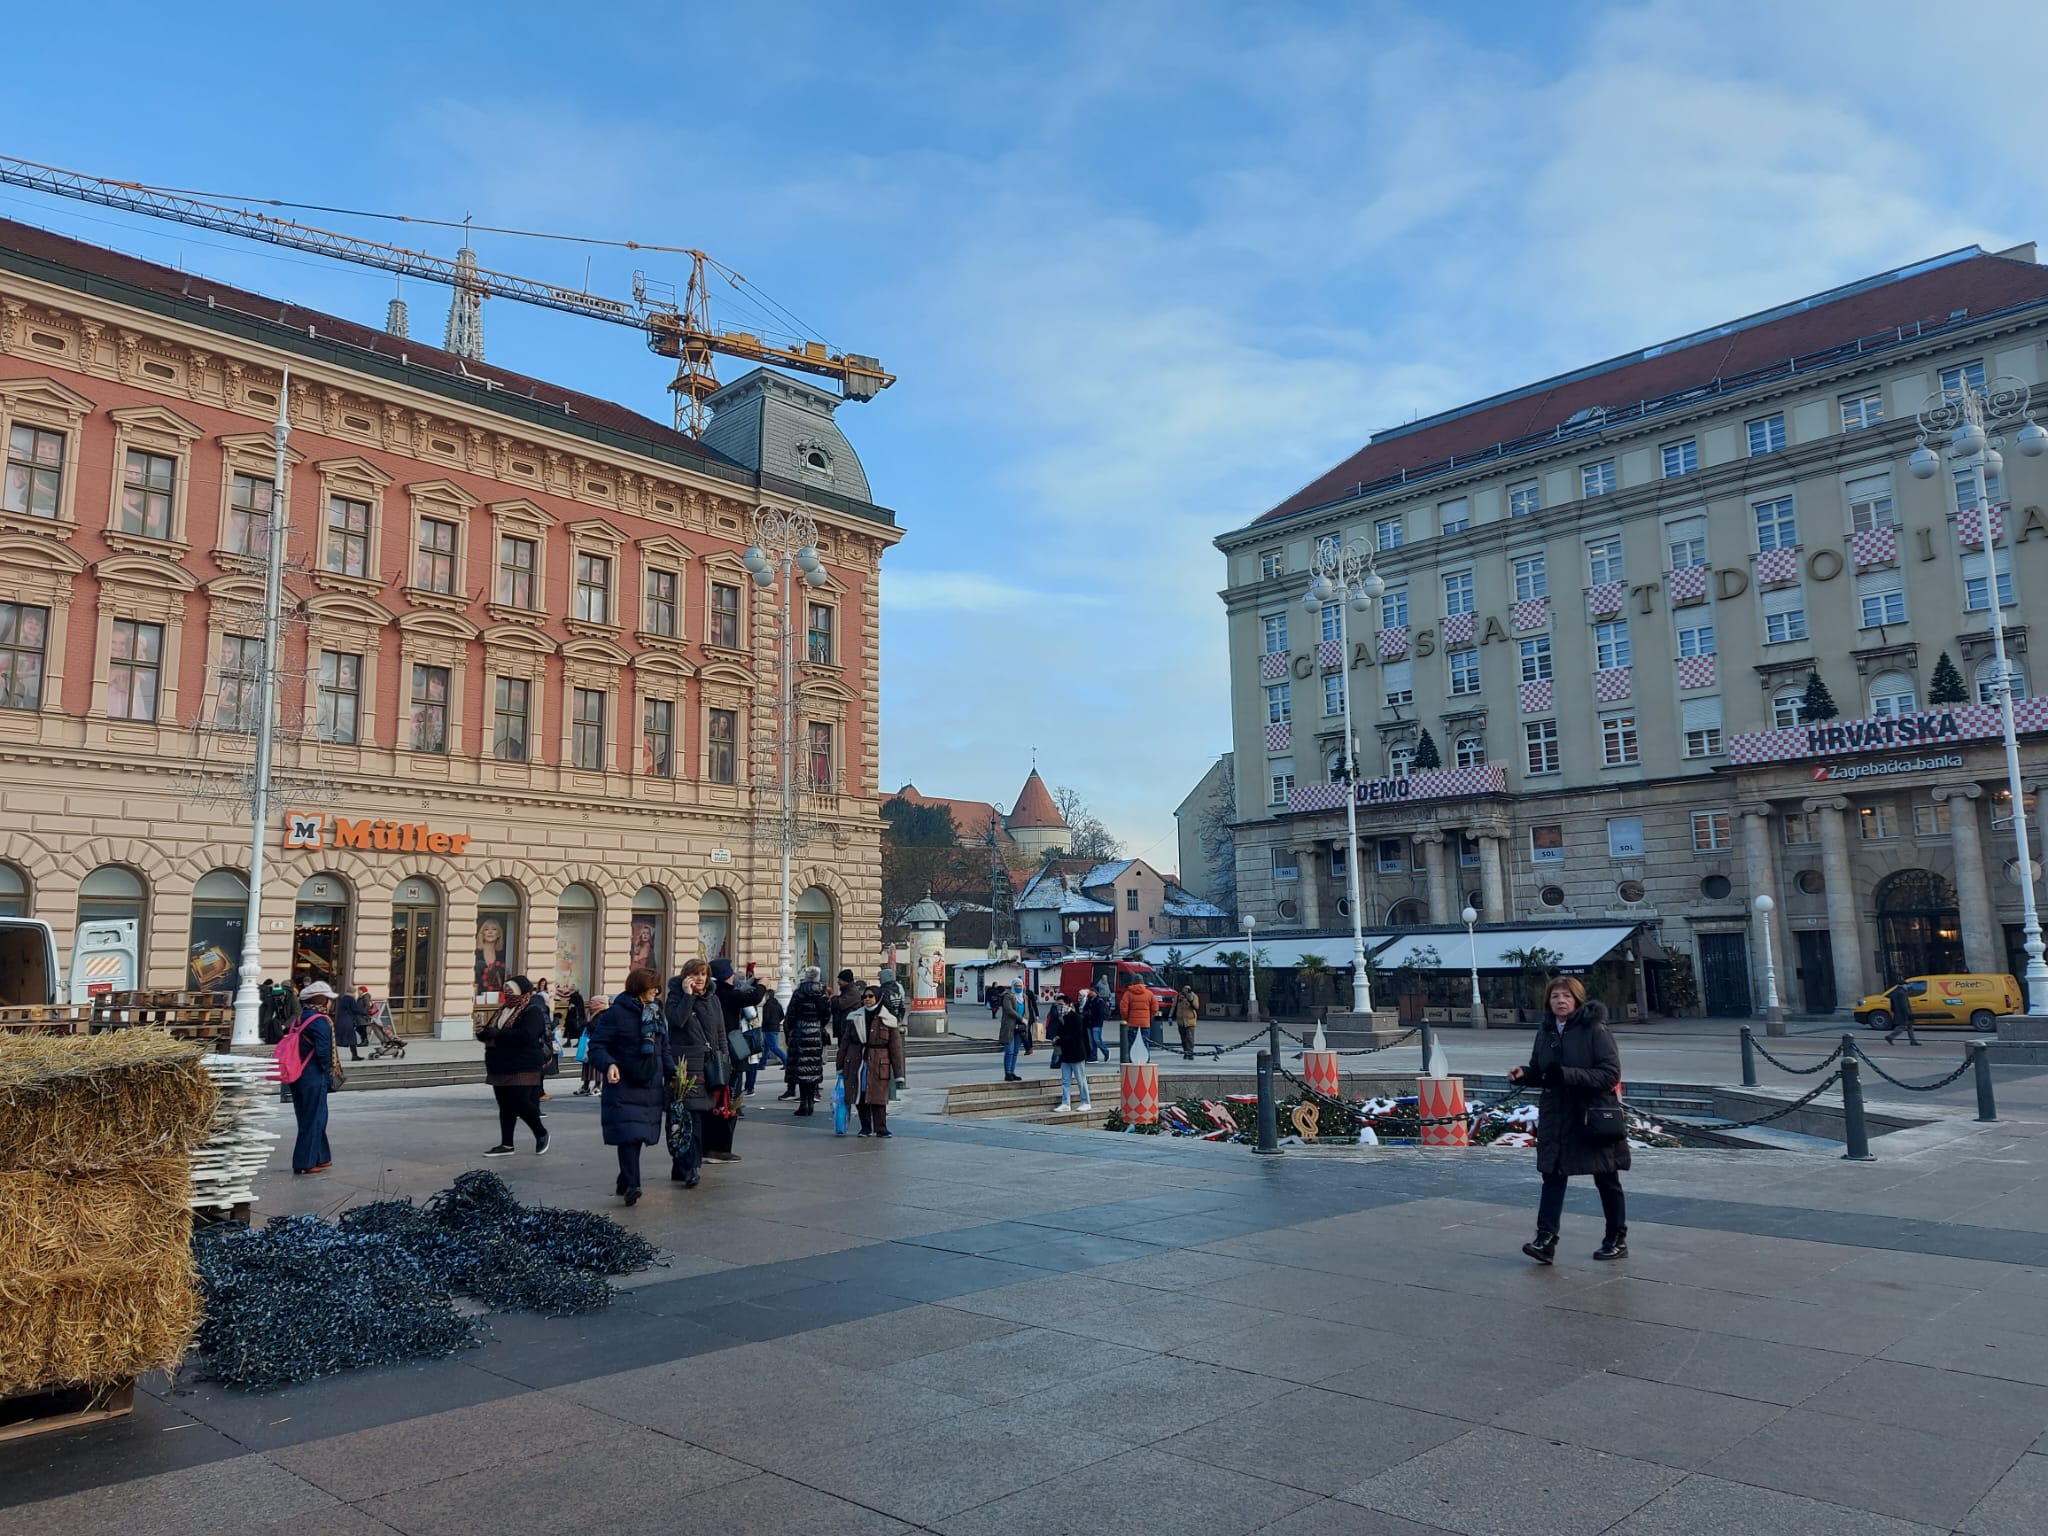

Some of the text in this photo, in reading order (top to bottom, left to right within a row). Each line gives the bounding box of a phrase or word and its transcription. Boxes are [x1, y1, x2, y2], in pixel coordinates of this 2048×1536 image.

[1808, 713, 1959, 751] HRVATSKA
[1828, 754, 1962, 780] Zagrebačka banka
[294, 822, 316, 839] M
[332, 817, 471, 854] Müller
